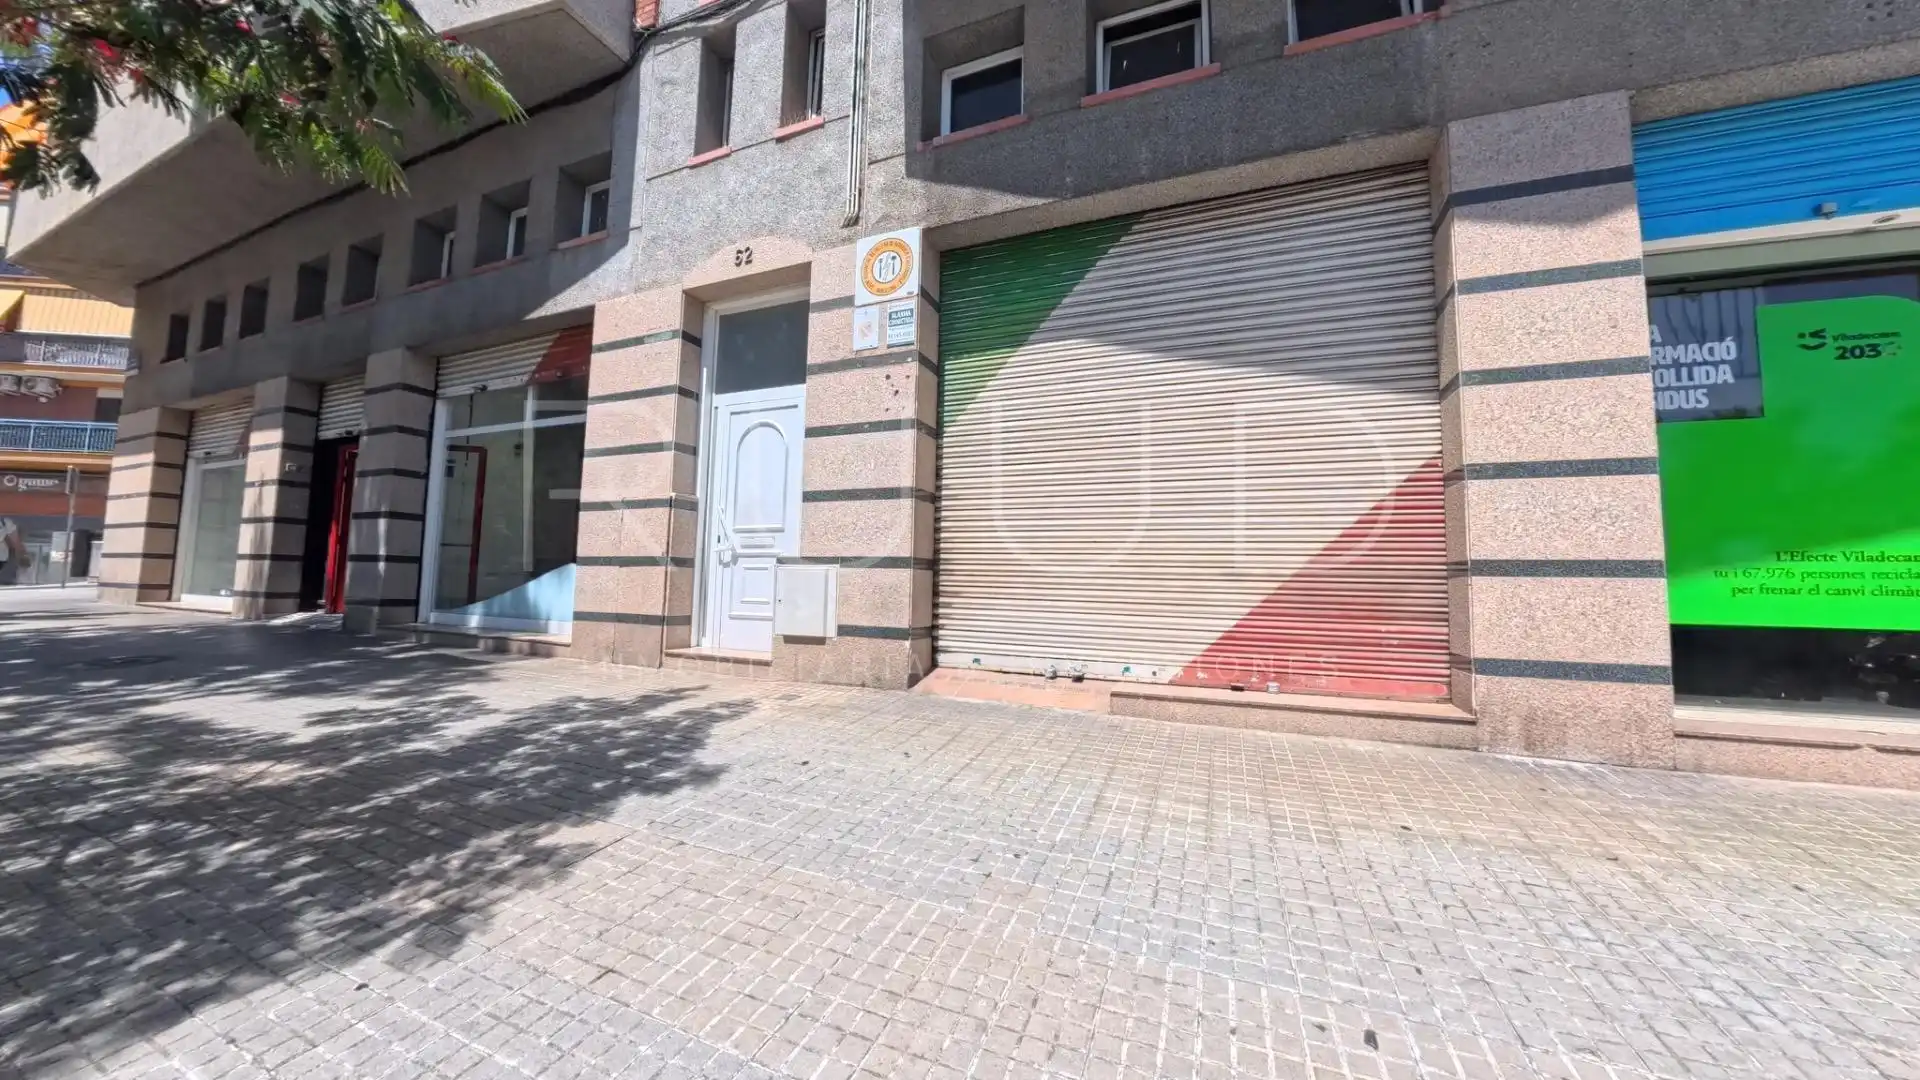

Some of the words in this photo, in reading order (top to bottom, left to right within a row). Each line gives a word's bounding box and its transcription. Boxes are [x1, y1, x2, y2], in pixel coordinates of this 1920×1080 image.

[1652, 364, 1735, 388] OLLIDA
[1655, 388, 1709, 411] IDUS
[1800, 571, 1866, 583] persones
[1731, 586, 1755, 598] per
[1760, 582, 1803, 596] frenar
[1808, 584, 1820, 596] el
[1825, 585, 1865, 597] canvi
